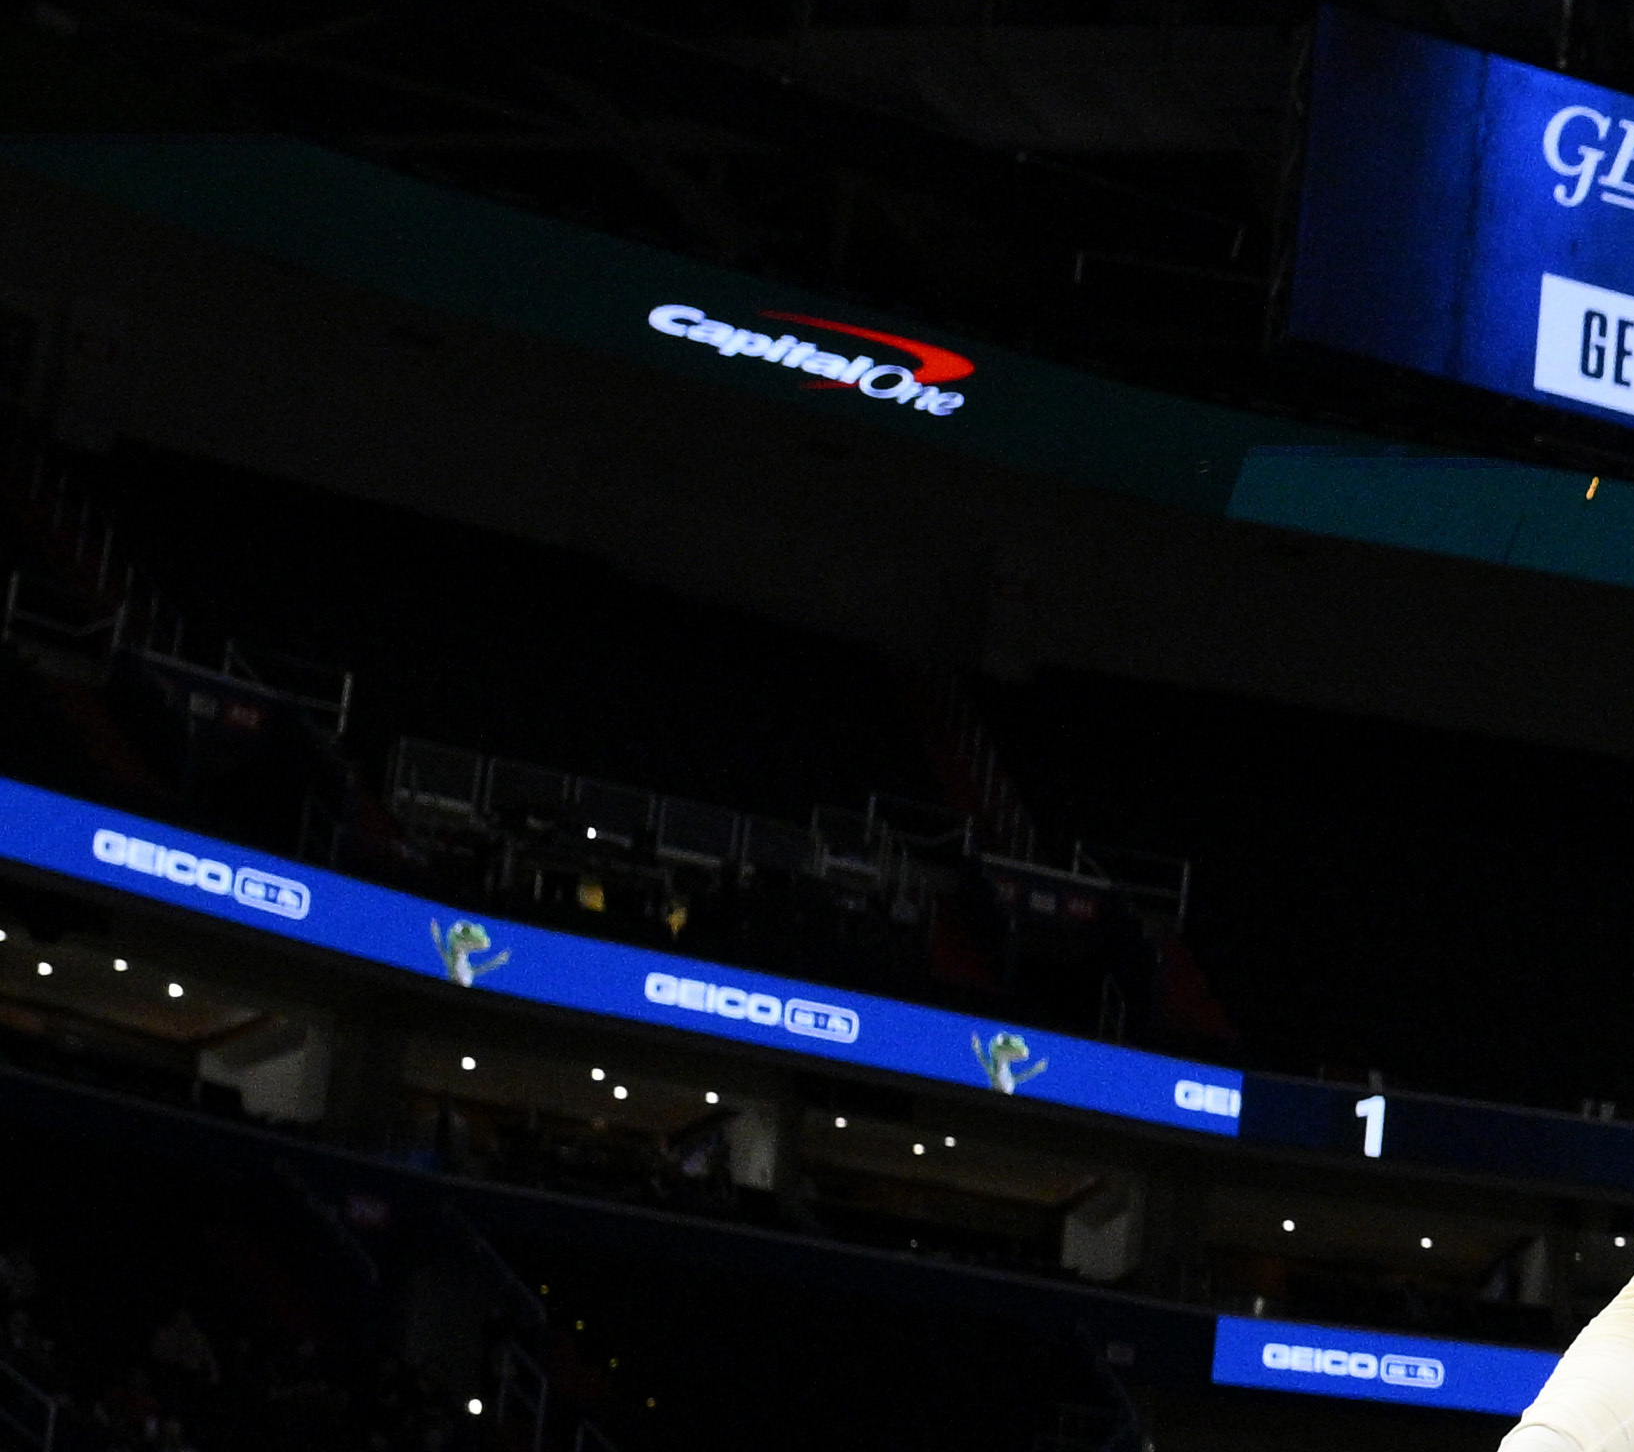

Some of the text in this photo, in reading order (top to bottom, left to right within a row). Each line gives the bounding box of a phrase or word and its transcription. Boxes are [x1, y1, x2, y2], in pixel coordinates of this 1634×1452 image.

[93, 828, 233, 896] GEICO
[644, 971, 782, 1026] GEICO
[1174, 1078, 1242, 1118] GEI
[1354, 1094, 1387, 1158] 1
[1262, 1343, 1378, 1380] GEICO
